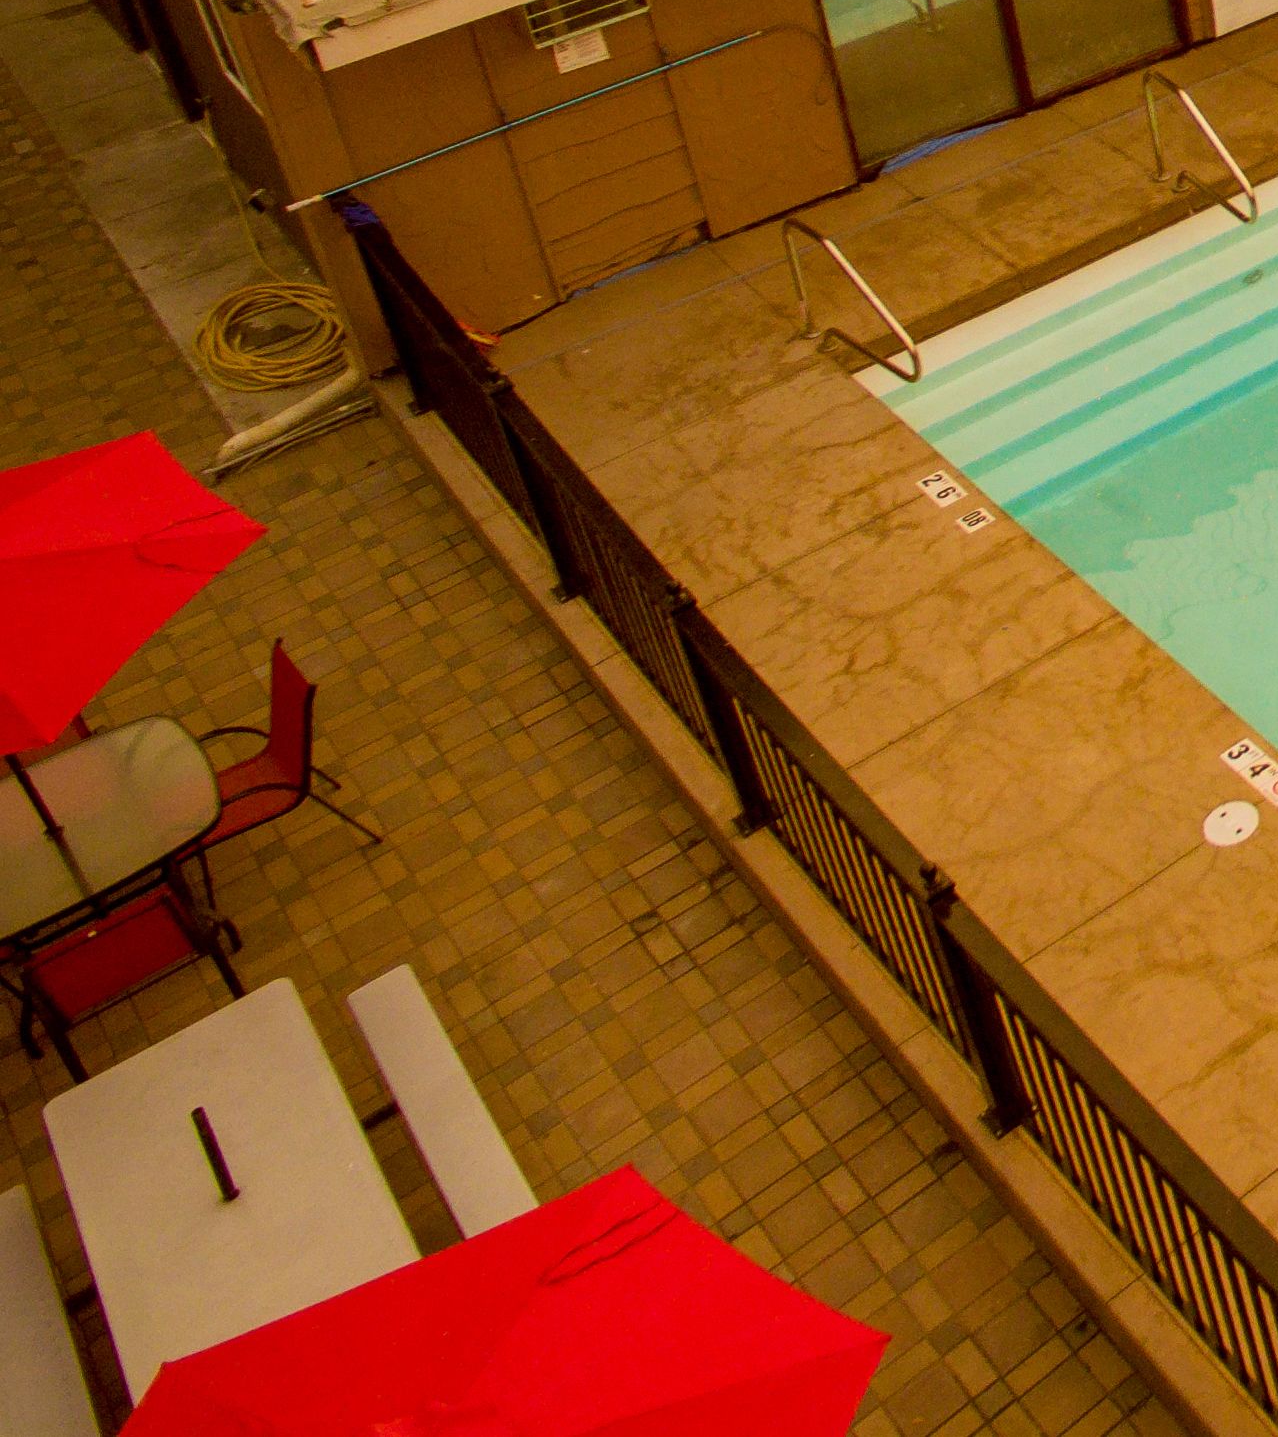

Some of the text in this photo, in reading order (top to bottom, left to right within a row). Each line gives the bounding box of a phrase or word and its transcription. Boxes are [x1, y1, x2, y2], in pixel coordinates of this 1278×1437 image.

[921, 473, 943, 488] 2
[936, 486, 957, 499] 6
[1227, 743, 1251, 760] 3
[1250, 762, 1270, 778] 4
